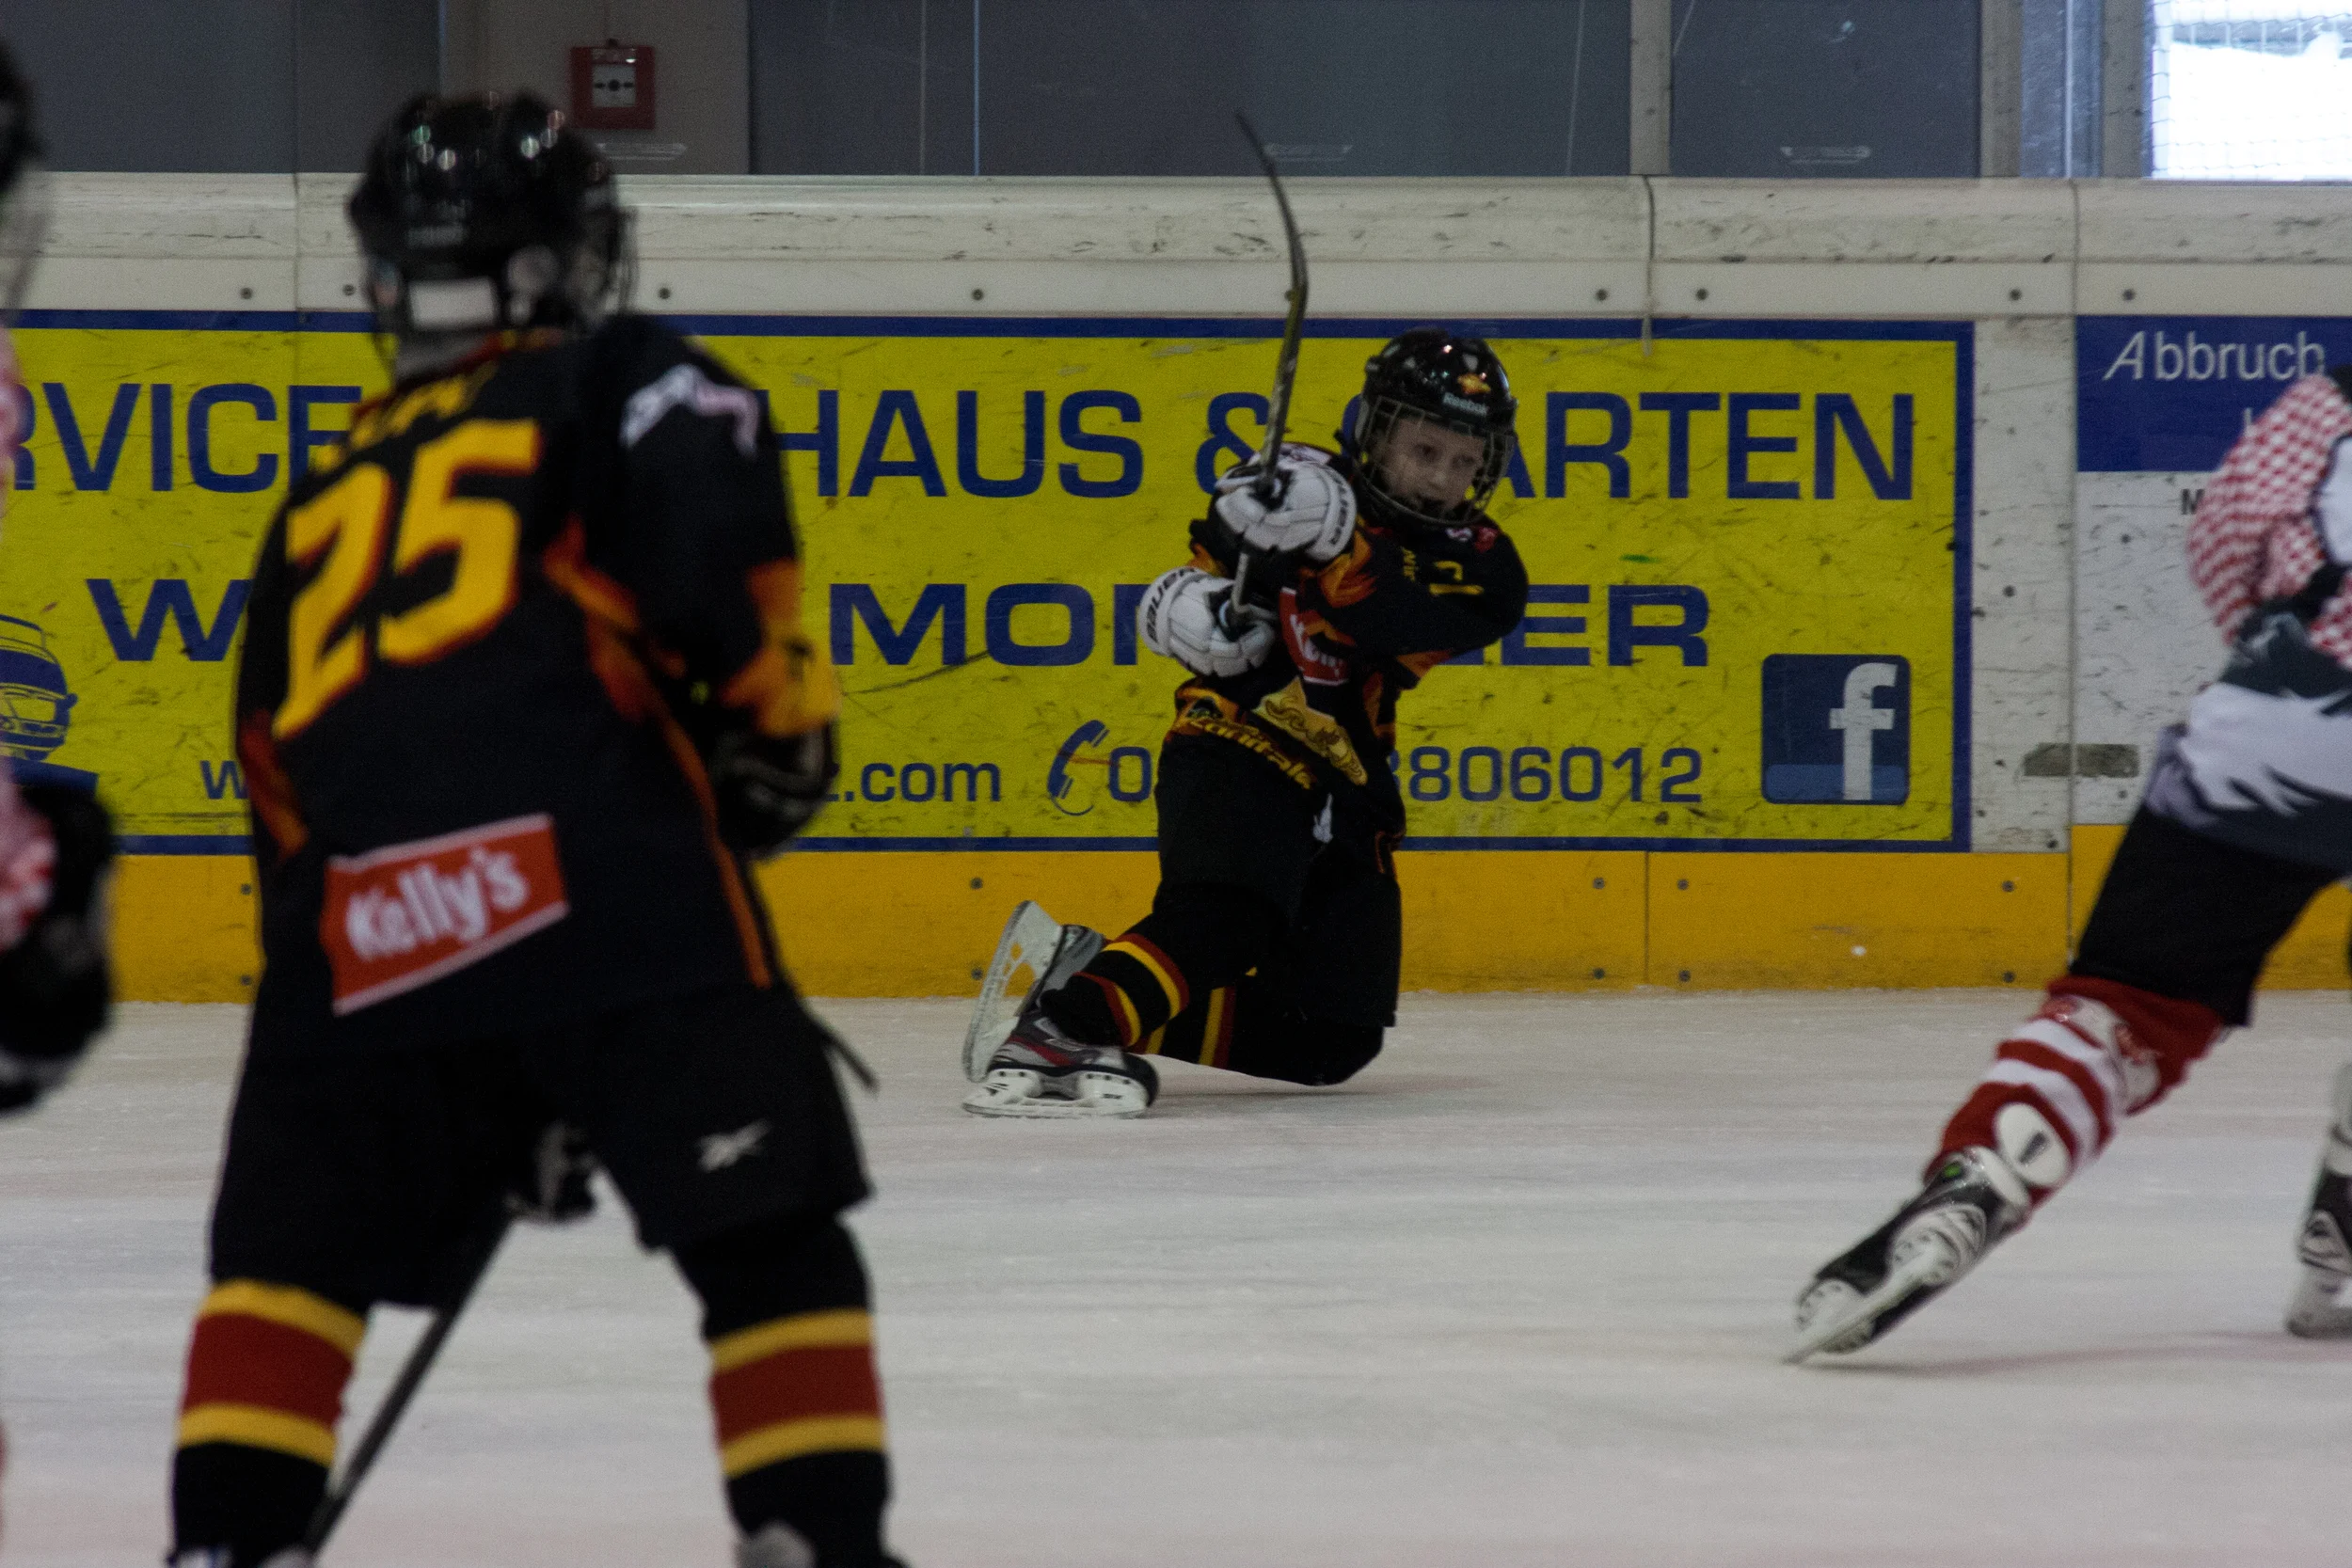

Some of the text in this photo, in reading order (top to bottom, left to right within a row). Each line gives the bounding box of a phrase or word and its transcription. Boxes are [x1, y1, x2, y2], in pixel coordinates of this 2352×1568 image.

[2102, 330, 2326, 381] Abbruch
[755, 388, 1144, 499] HAUS
[273, 416, 538, 740] 25
[1390, 745, 1704, 802] 806012
[345, 847, 530, 962] Kelly's
